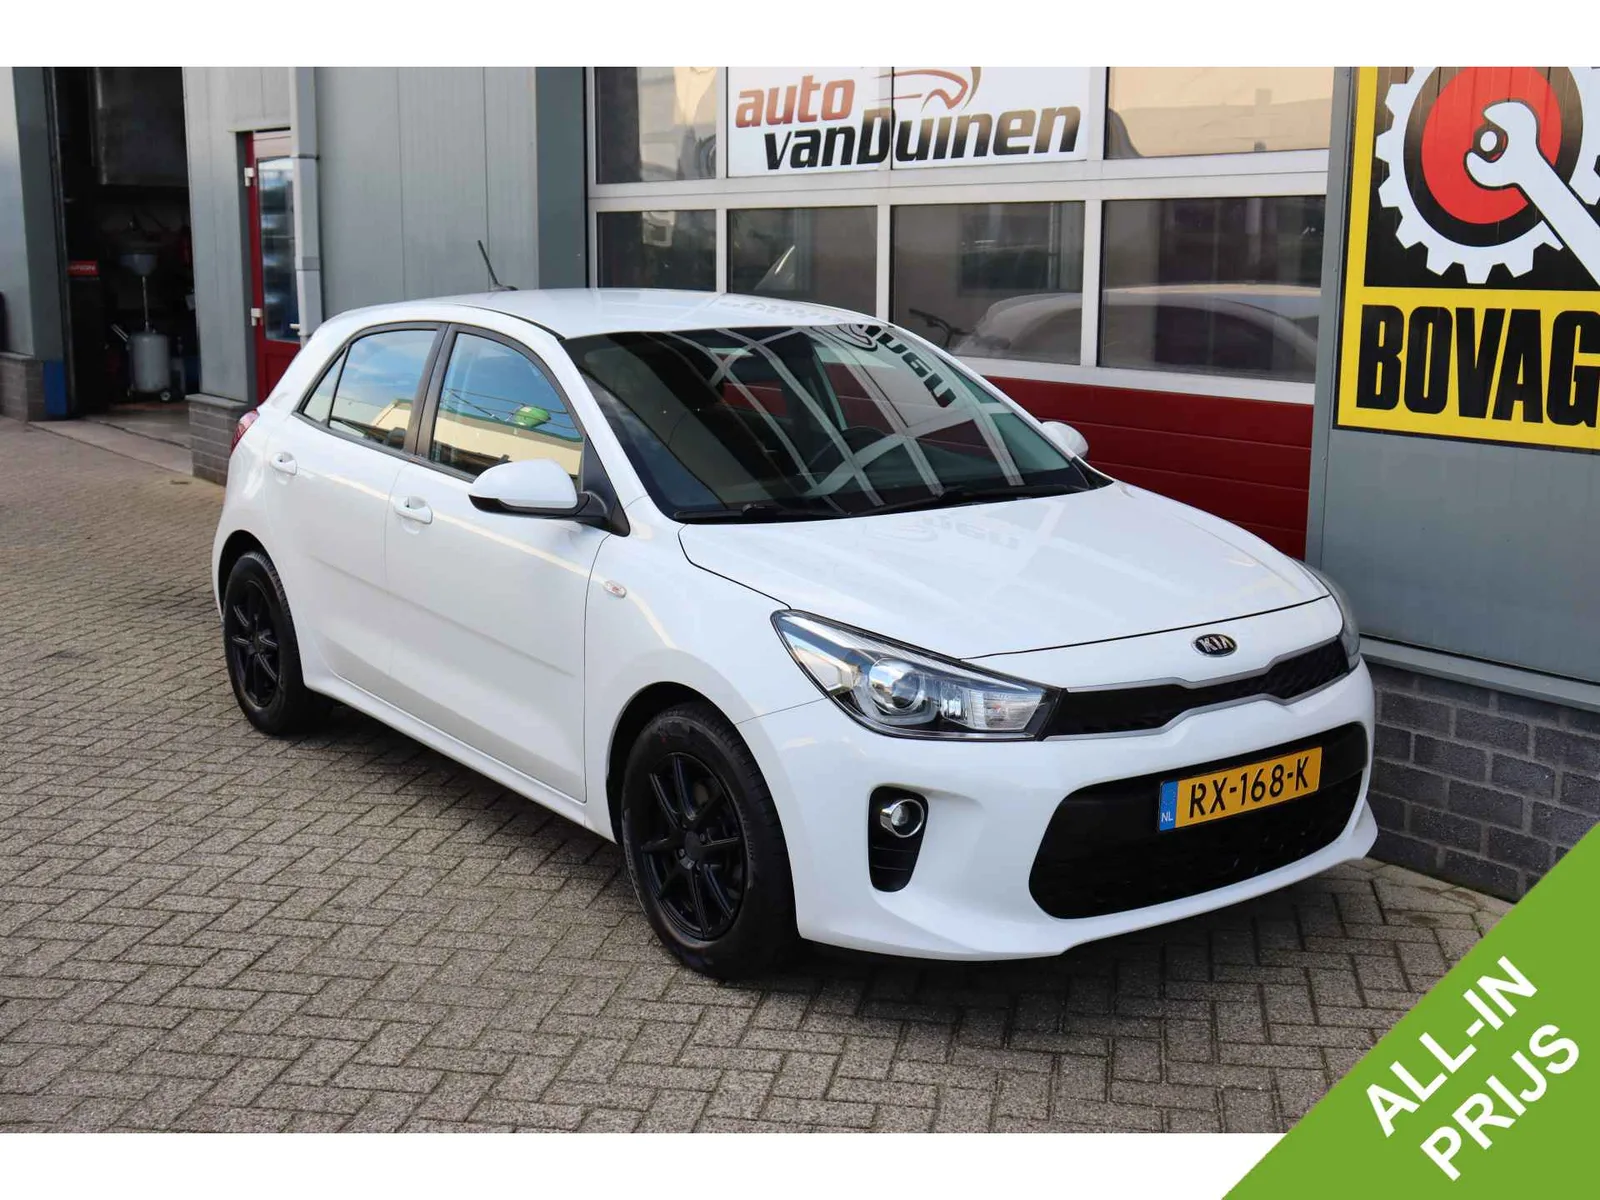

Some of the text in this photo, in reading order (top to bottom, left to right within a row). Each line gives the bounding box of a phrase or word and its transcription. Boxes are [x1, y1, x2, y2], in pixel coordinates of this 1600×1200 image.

[735, 75, 855, 128] auto
[1356, 304, 1600, 428] BOVAG
[1198, 635, 1234, 652] KIA
[1160, 756, 1310, 823] NL RX-168-K
